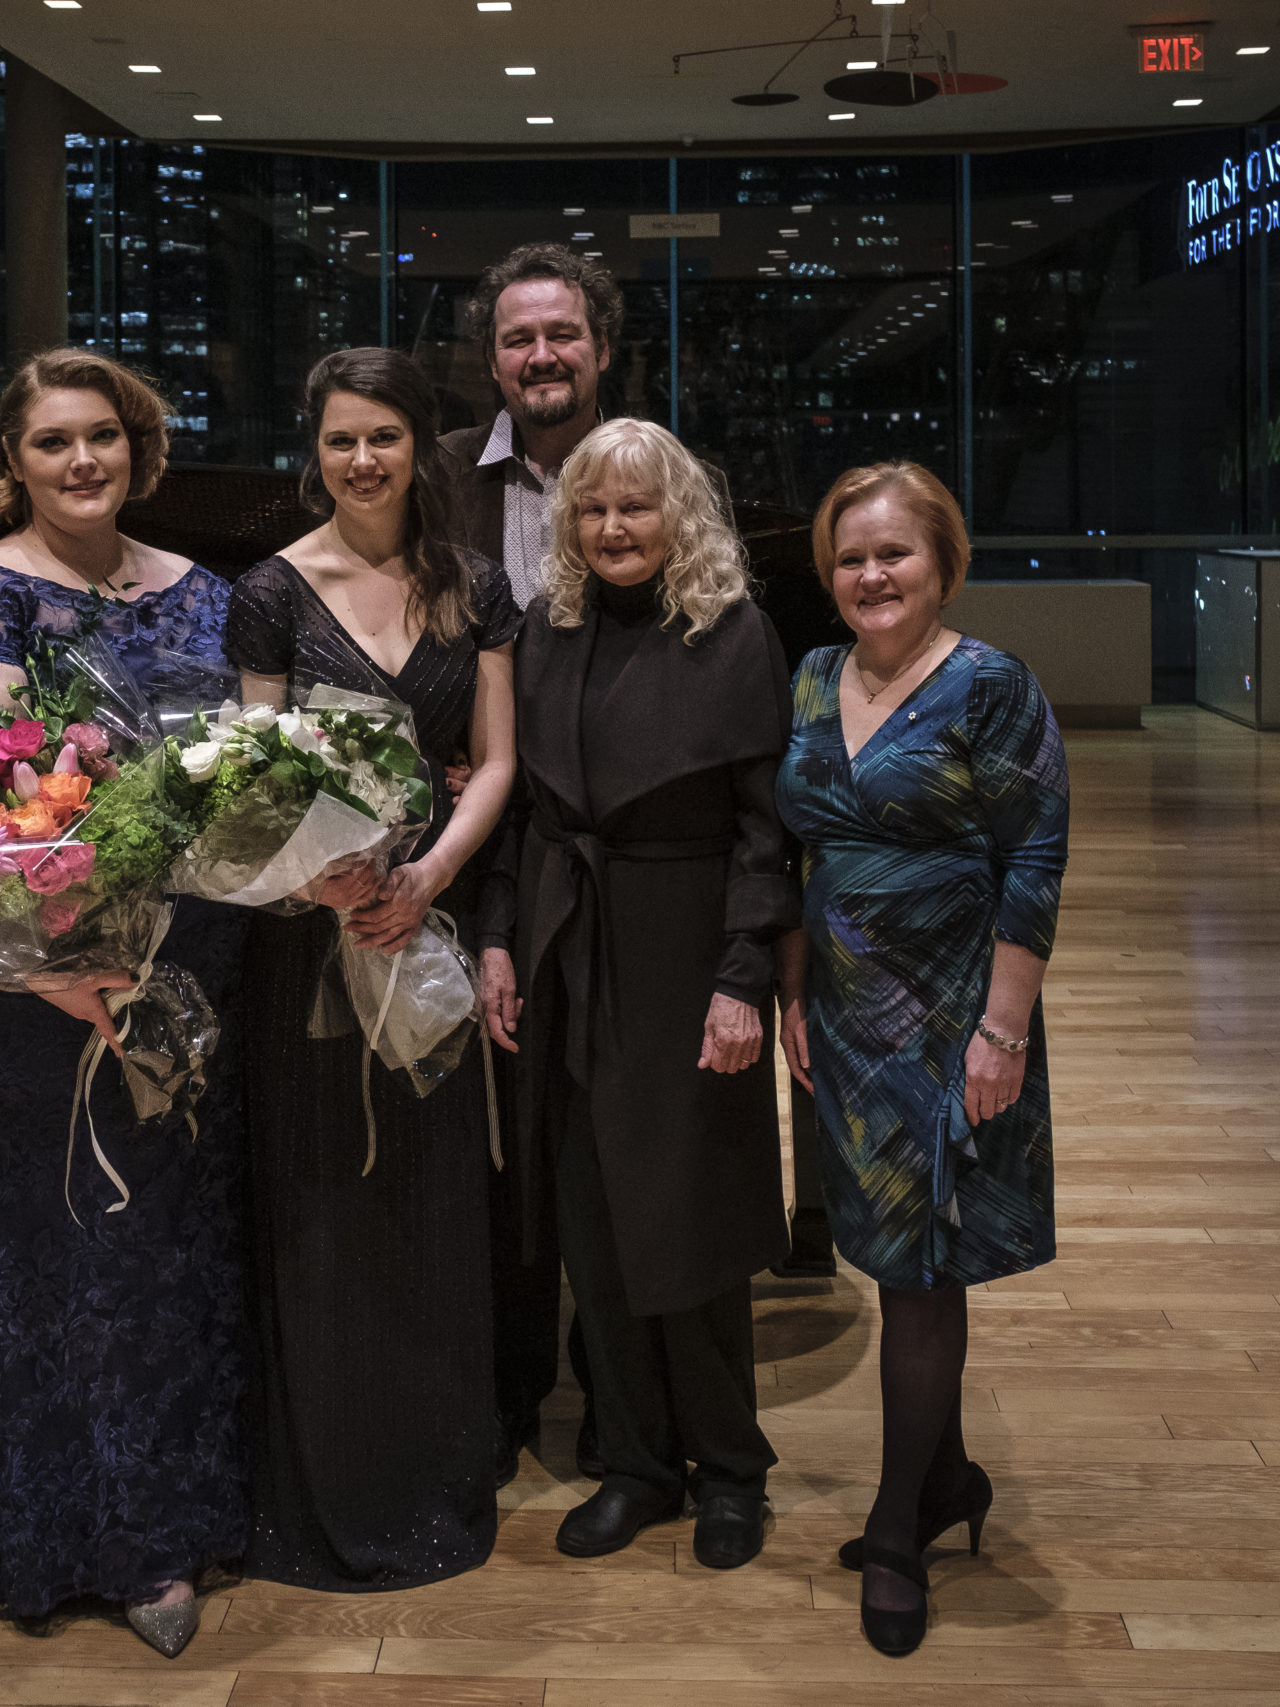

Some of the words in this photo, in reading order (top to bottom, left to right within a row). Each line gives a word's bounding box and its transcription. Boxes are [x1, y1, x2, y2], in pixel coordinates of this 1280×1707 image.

[1143, 37, 1194, 72] EXIT
[1188, 234, 1208, 267] FOR
[1211, 222, 1232, 256] THE
